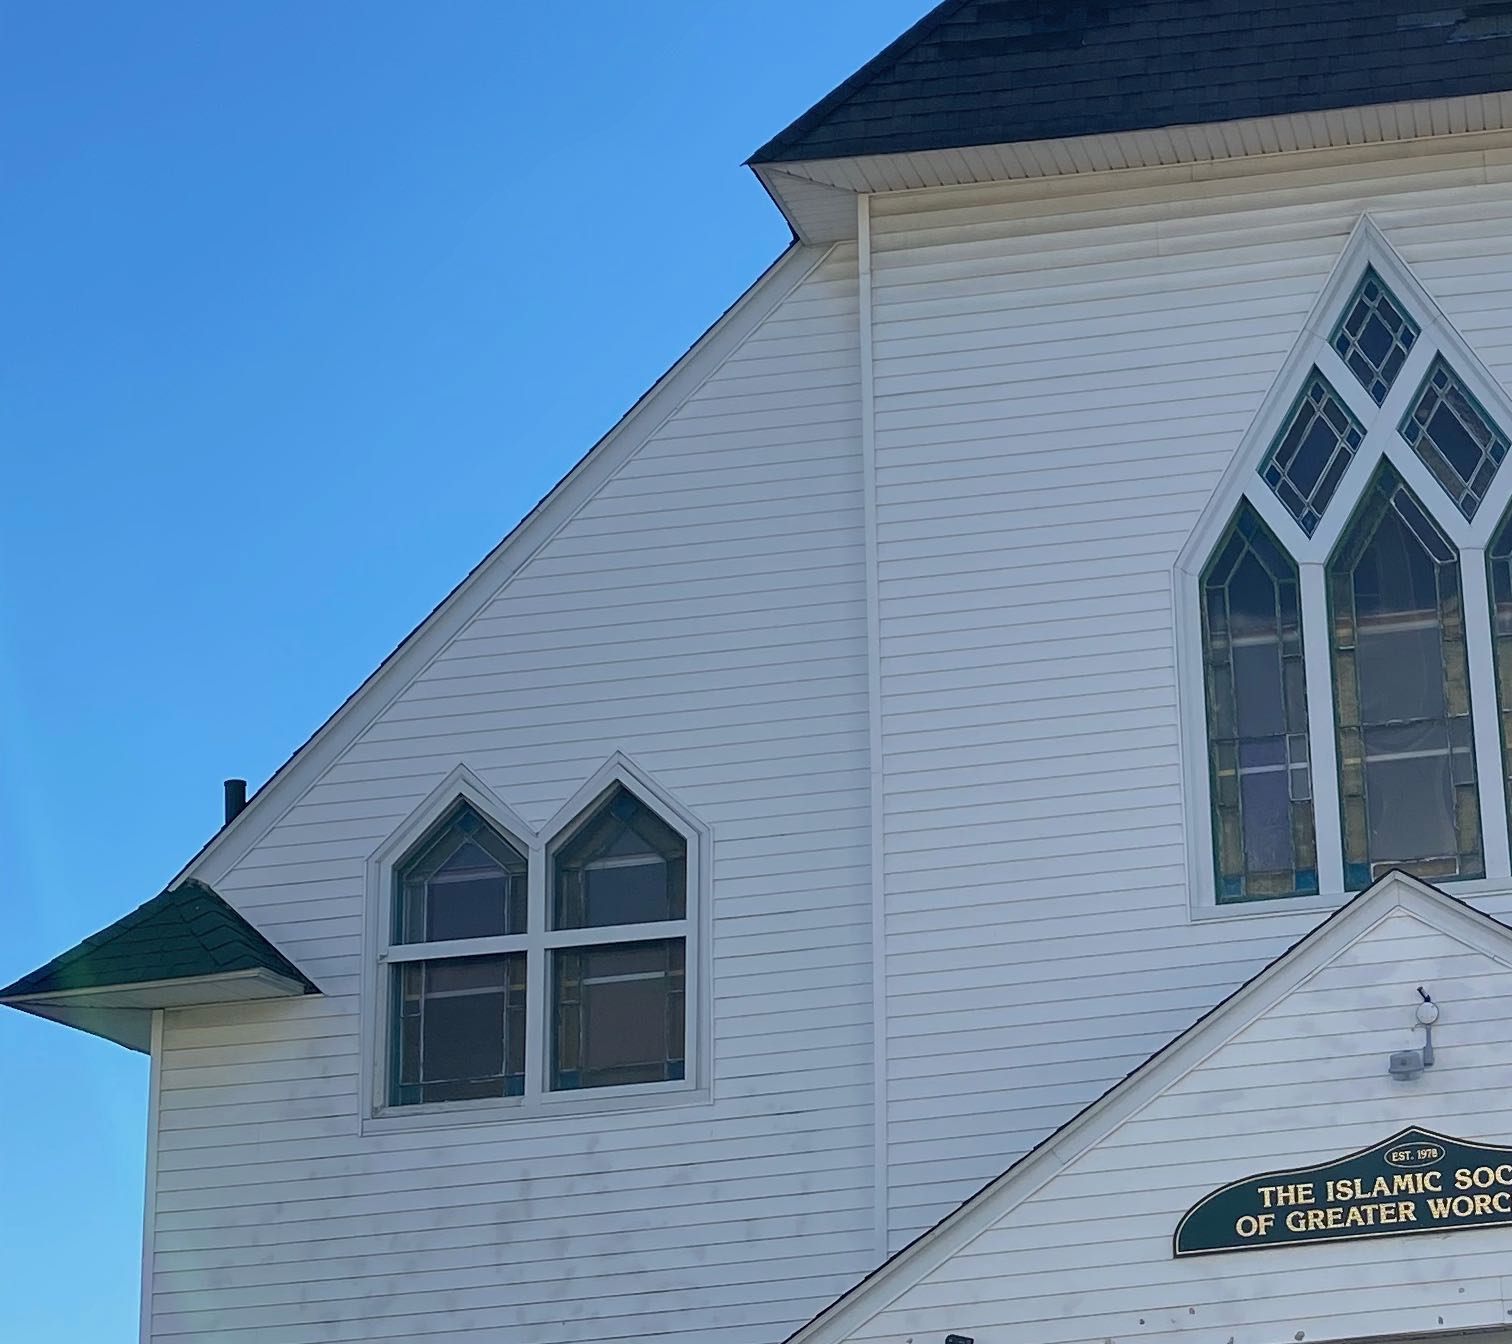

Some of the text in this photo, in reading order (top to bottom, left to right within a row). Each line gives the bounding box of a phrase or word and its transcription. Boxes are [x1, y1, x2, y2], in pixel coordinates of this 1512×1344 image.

[1392, 1151, 1414, 1162] EST.
[1258, 1183, 1315, 1208] THE
[1326, 1171, 1443, 1202] ISLAMIC
[1236, 1214, 1275, 1237] OF
[1285, 1200, 1417, 1232] GREATER
